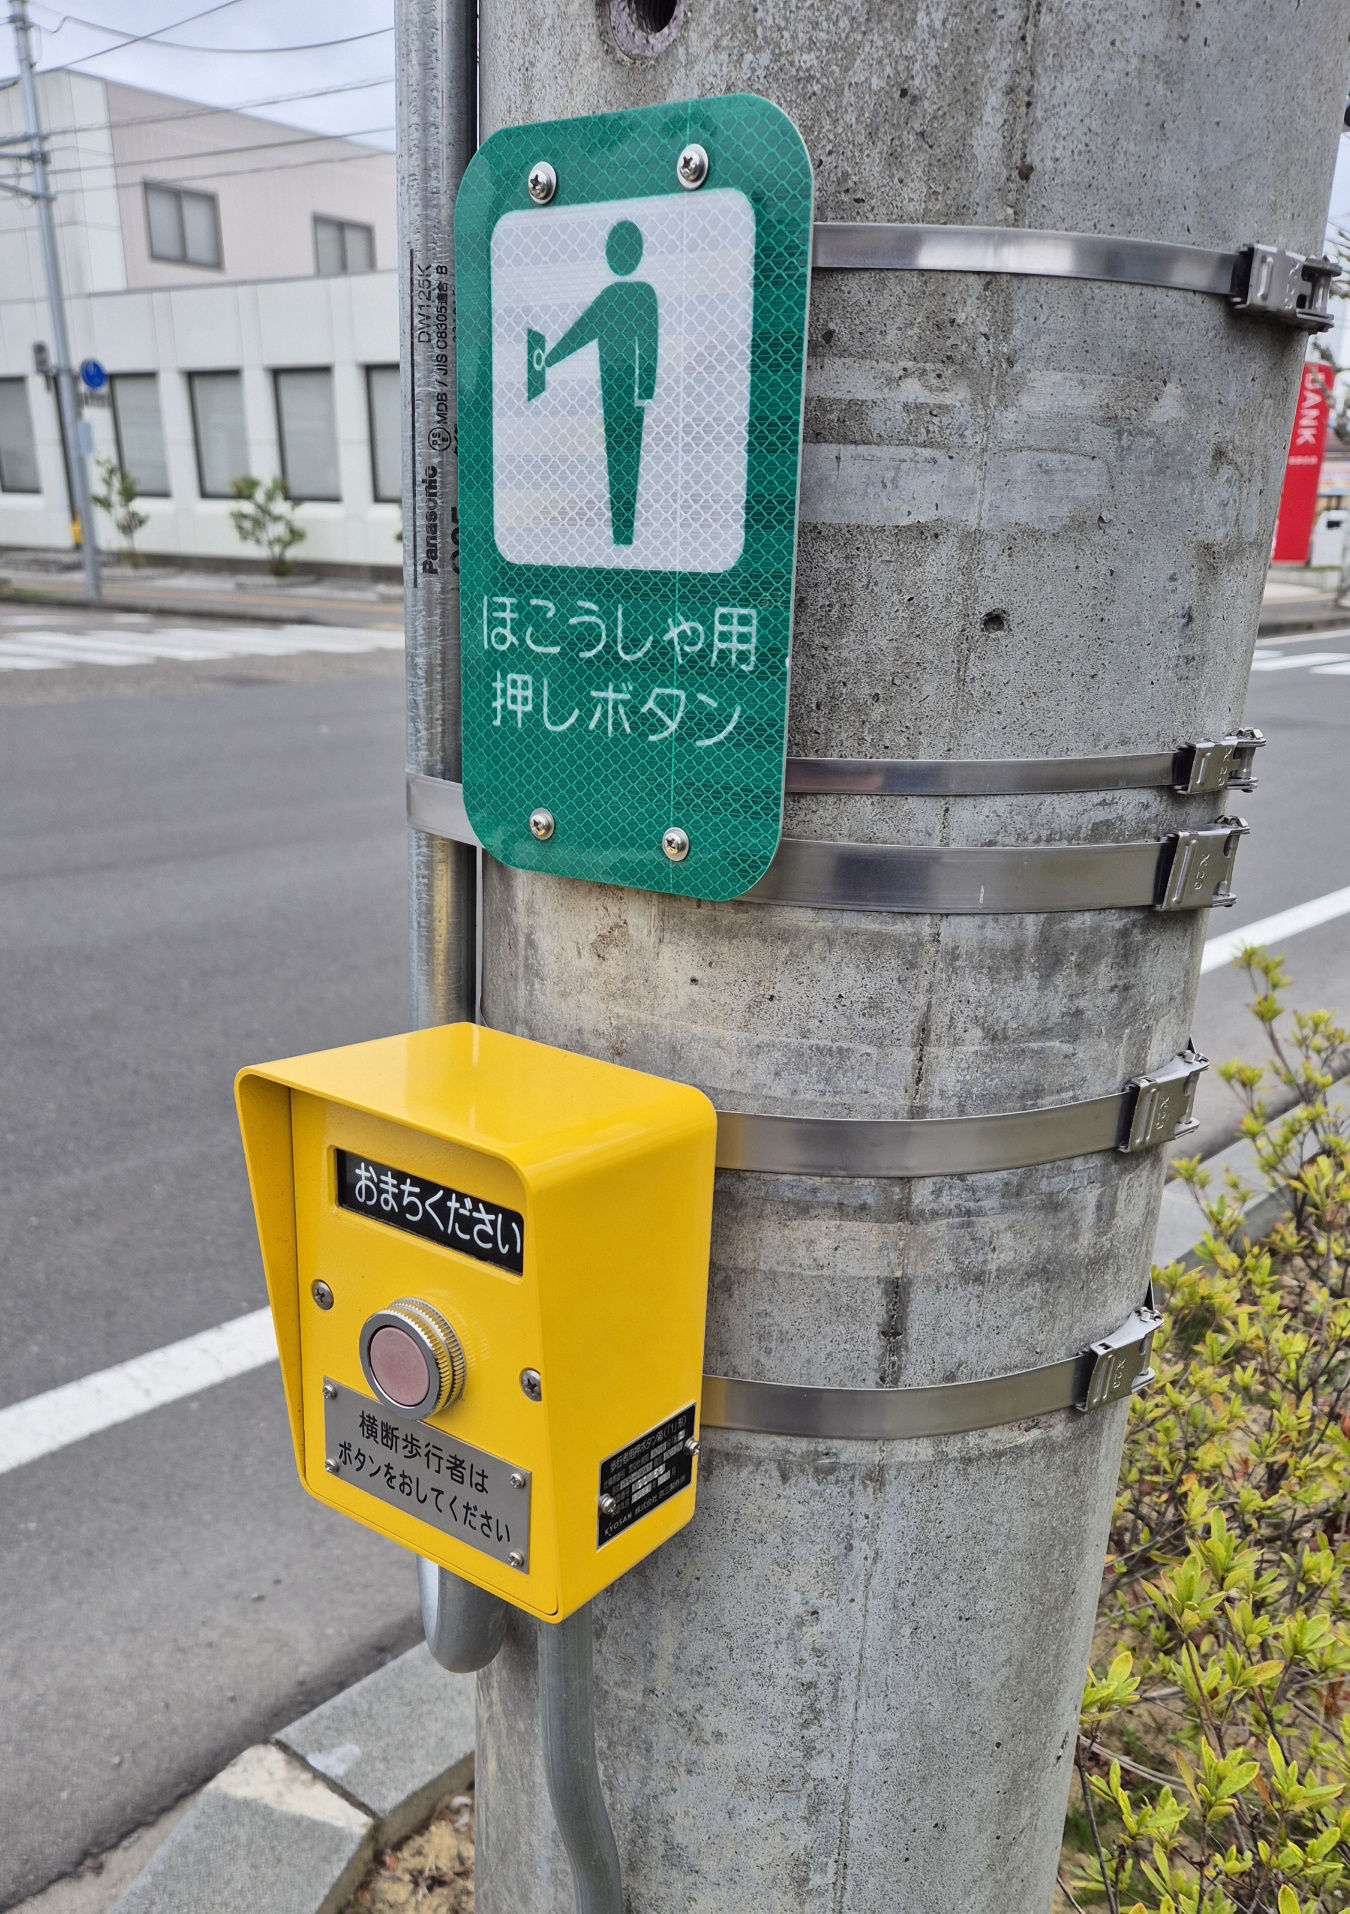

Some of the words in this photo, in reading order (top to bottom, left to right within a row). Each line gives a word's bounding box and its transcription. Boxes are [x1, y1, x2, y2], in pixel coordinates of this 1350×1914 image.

[418, 264, 432, 343] DW125K
[436, 265, 448, 274] B
[436, 354, 448, 375] JIS
[422, 465, 439, 574] Panasonic
[491, 671, 741, 746] 押しボタン
[355, 1161, 522, 1255] おまちください
[338, 1440, 511, 1543] ボタンをおしてください
[358, 1409, 489, 1494] 横断歩行者は
